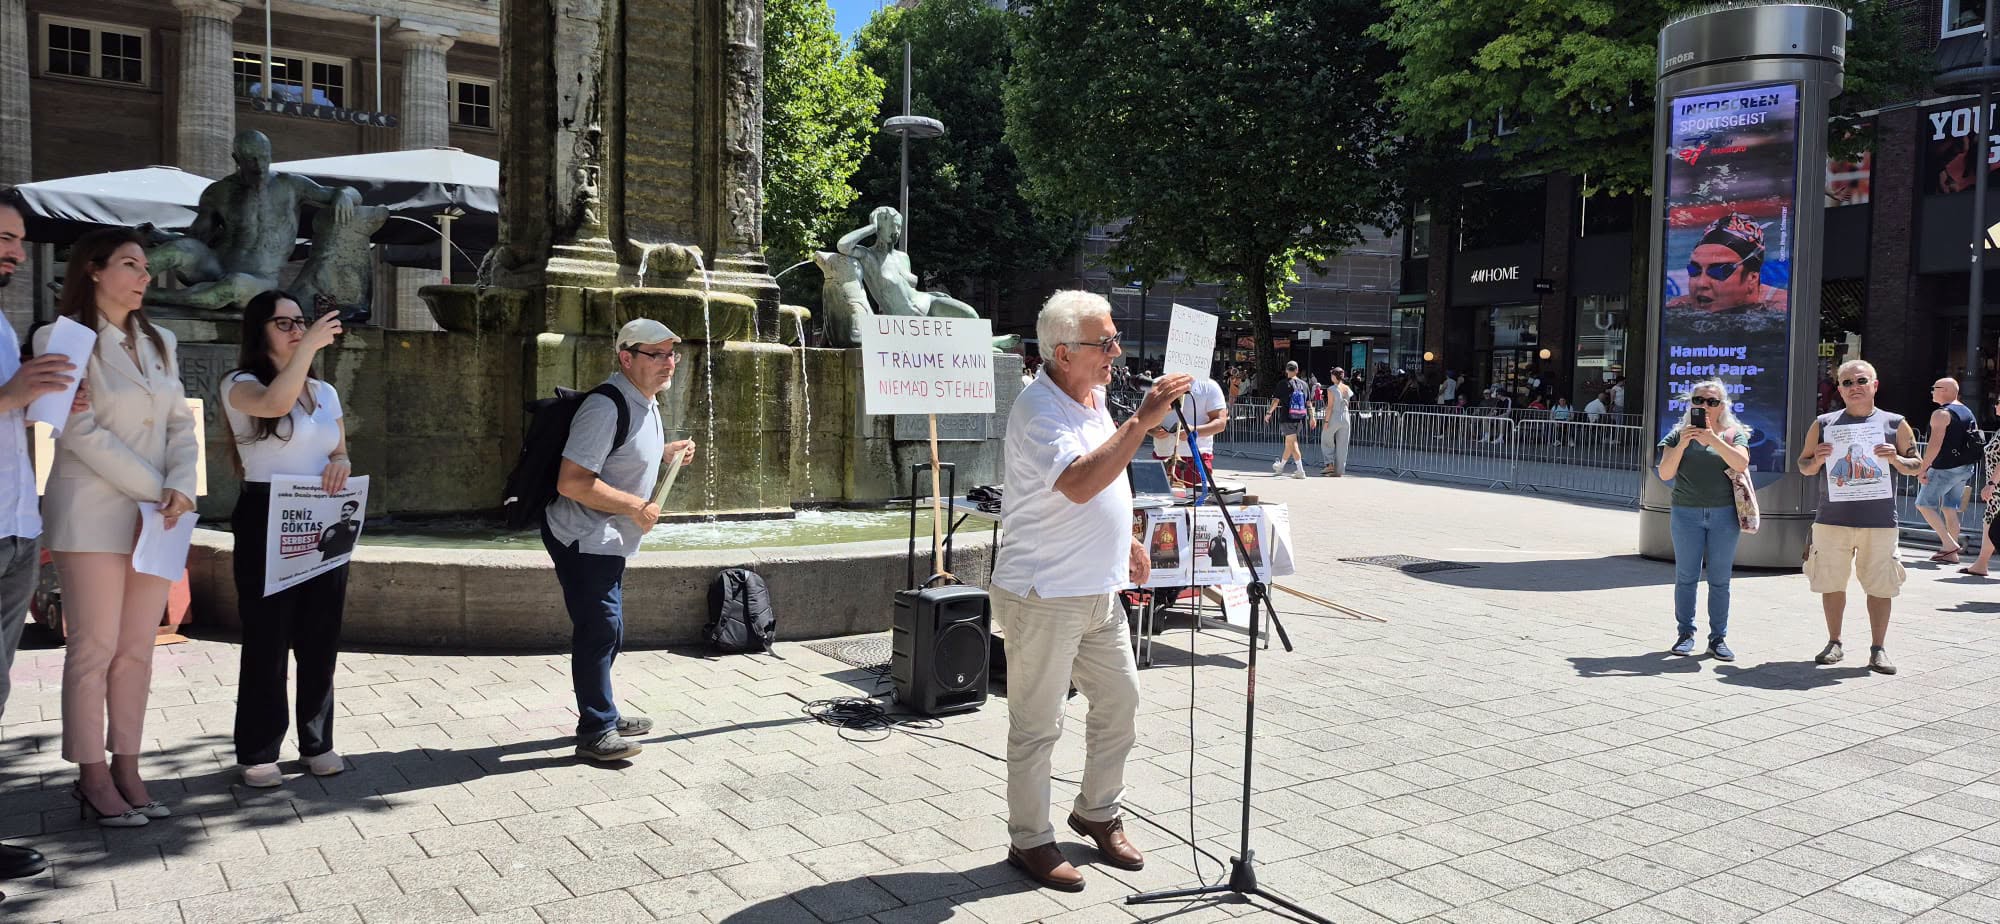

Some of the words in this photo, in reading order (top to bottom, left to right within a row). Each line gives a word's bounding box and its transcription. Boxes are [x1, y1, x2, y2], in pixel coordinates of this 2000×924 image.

[1664, 51, 1694, 68] STRÖER
[250, 98, 398, 127] STARBUCKS
[1681, 94, 1779, 115] INFOSCREEN
[1680, 112, 1767, 131] SPORTSGEIST
[1485, 266, 1519, 282] HOME
[878, 319, 953, 336] UNSERE
[877, 350, 944, 368] TRÄUME
[952, 353, 986, 368] KANN
[1670, 345, 1746, 359] Hamburg
[1670, 362, 1715, 375] feiert
[1719, 363, 1764, 375] Para-
[879, 379, 928, 397] NIEMAD
[935, 380, 993, 398] STEHLEN
[1668, 380, 1751, 394] Trion-
[282, 508, 312, 520] DENİZ
[282, 535, 317, 545] SERBEST
